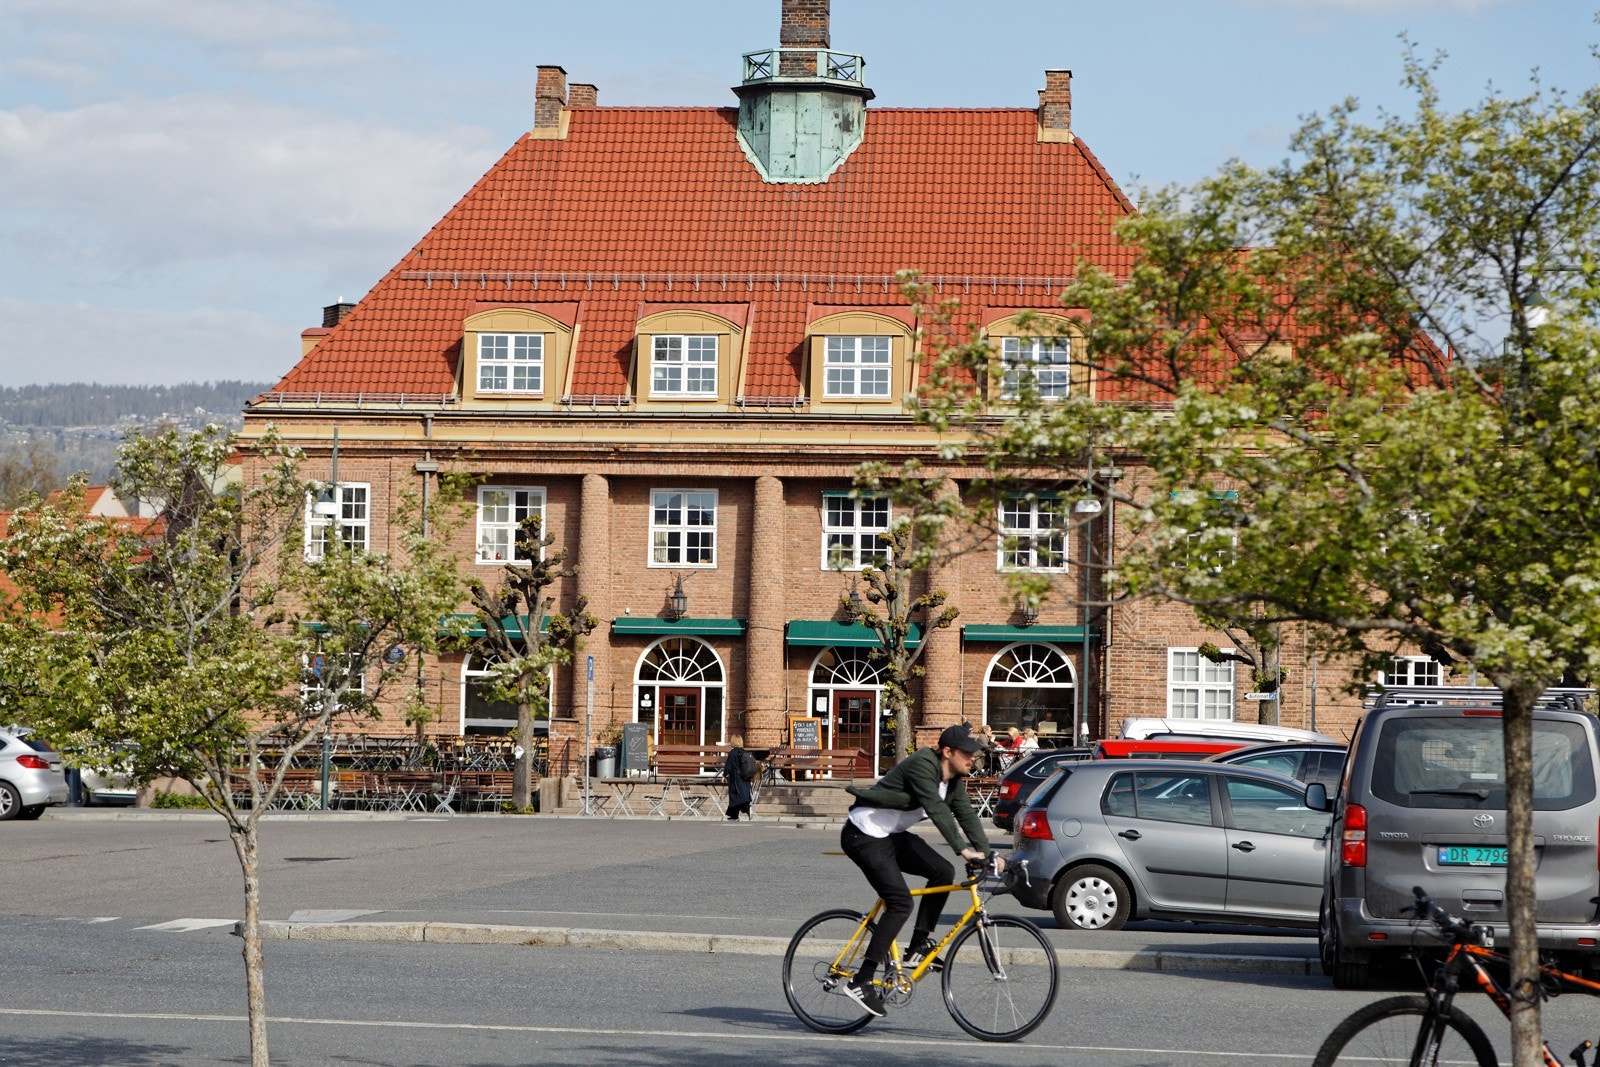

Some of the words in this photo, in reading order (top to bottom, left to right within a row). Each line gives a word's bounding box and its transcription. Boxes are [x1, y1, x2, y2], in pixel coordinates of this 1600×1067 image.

[1379, 831, 1410, 839] TOYOTA
[1553, 834, 1591, 842] PROACE
[1450, 848, 1469, 861] DR
[1475, 849, 1509, 862] 2796
